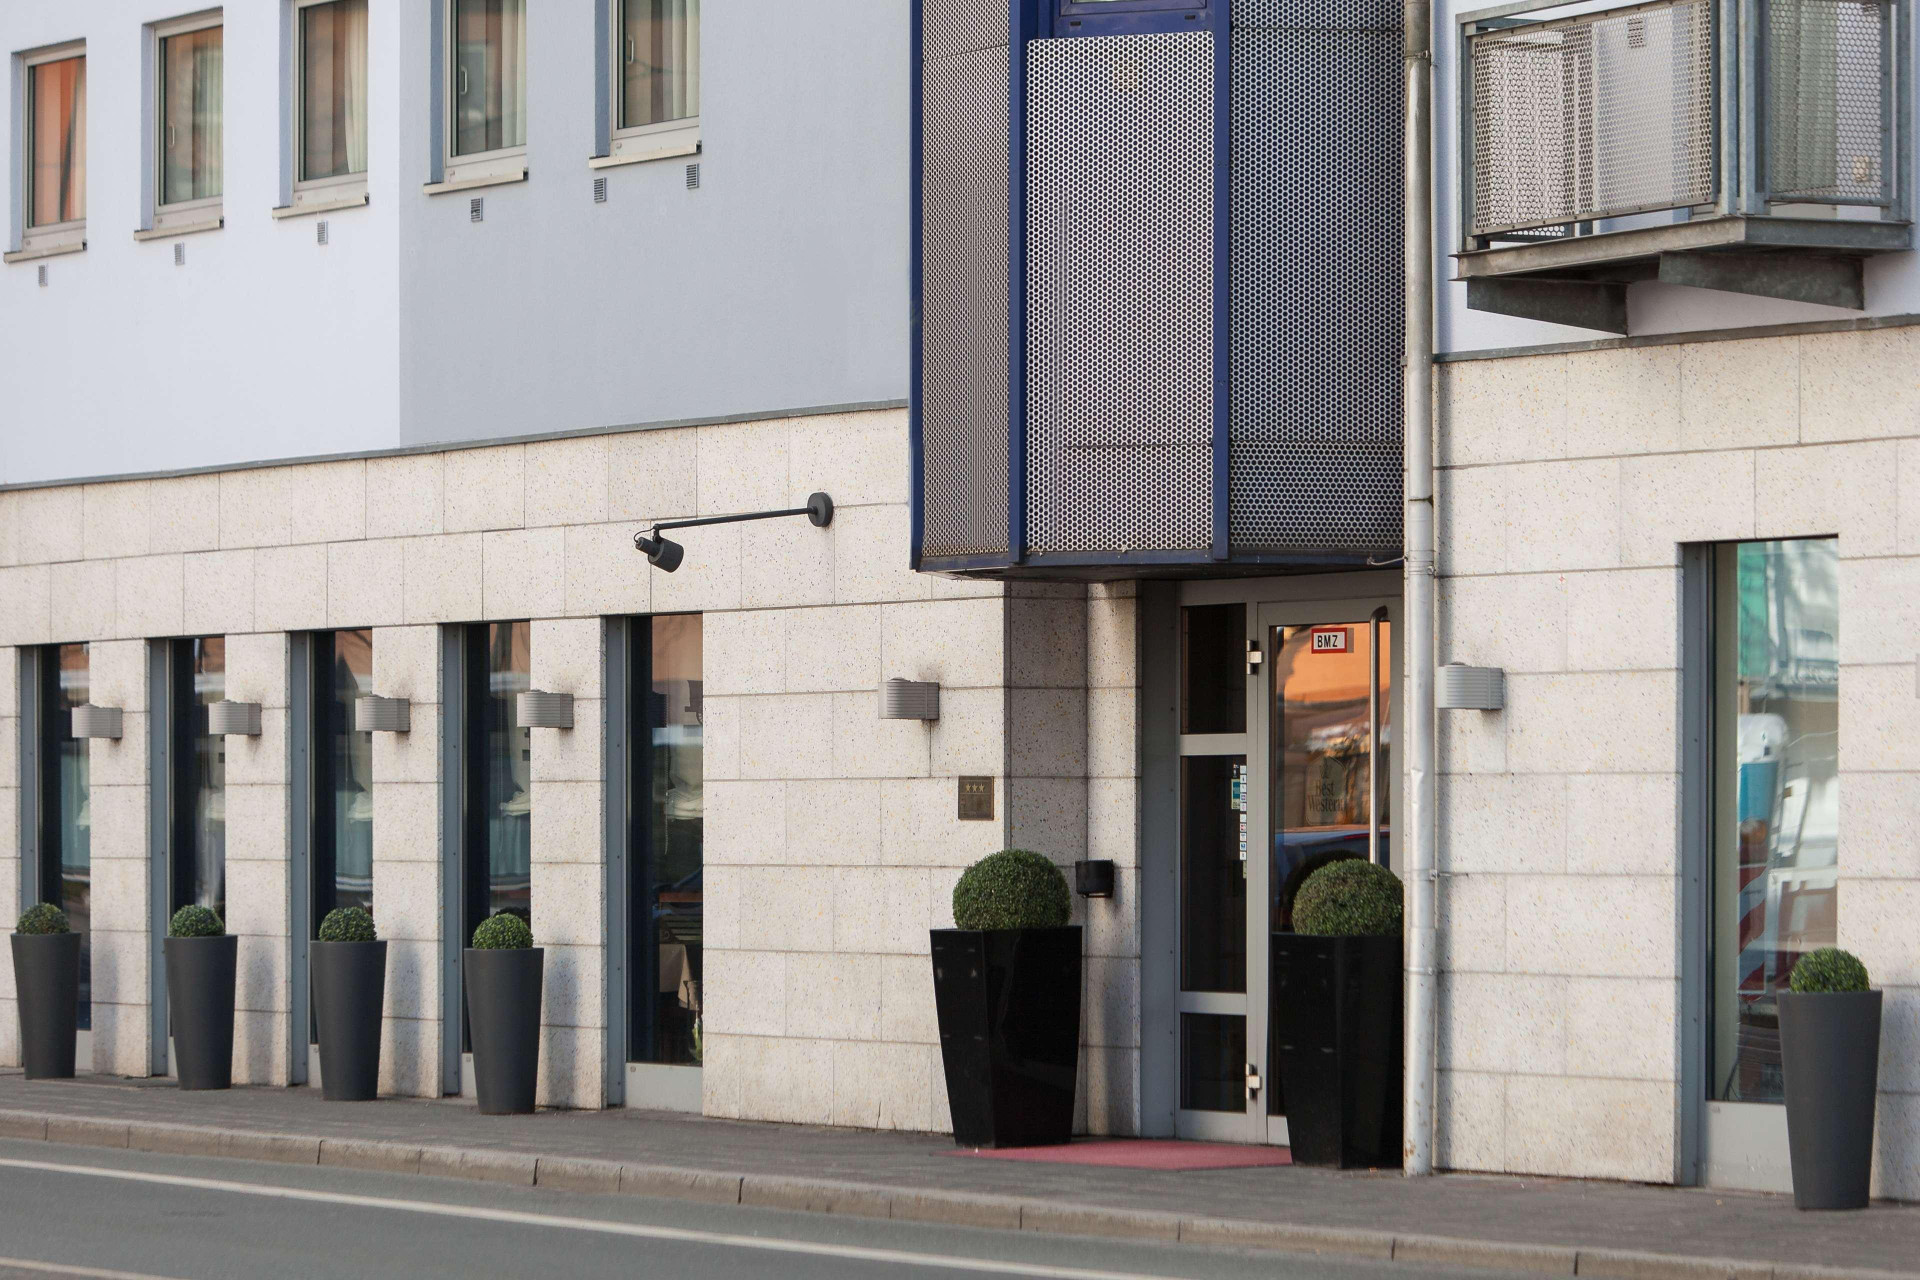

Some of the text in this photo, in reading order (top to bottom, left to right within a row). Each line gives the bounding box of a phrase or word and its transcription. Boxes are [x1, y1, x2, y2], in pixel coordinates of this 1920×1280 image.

[1317, 634, 1338, 648] BMZ
[1316, 780, 1335, 797] Best
[1307, 795, 1344, 812] Western
